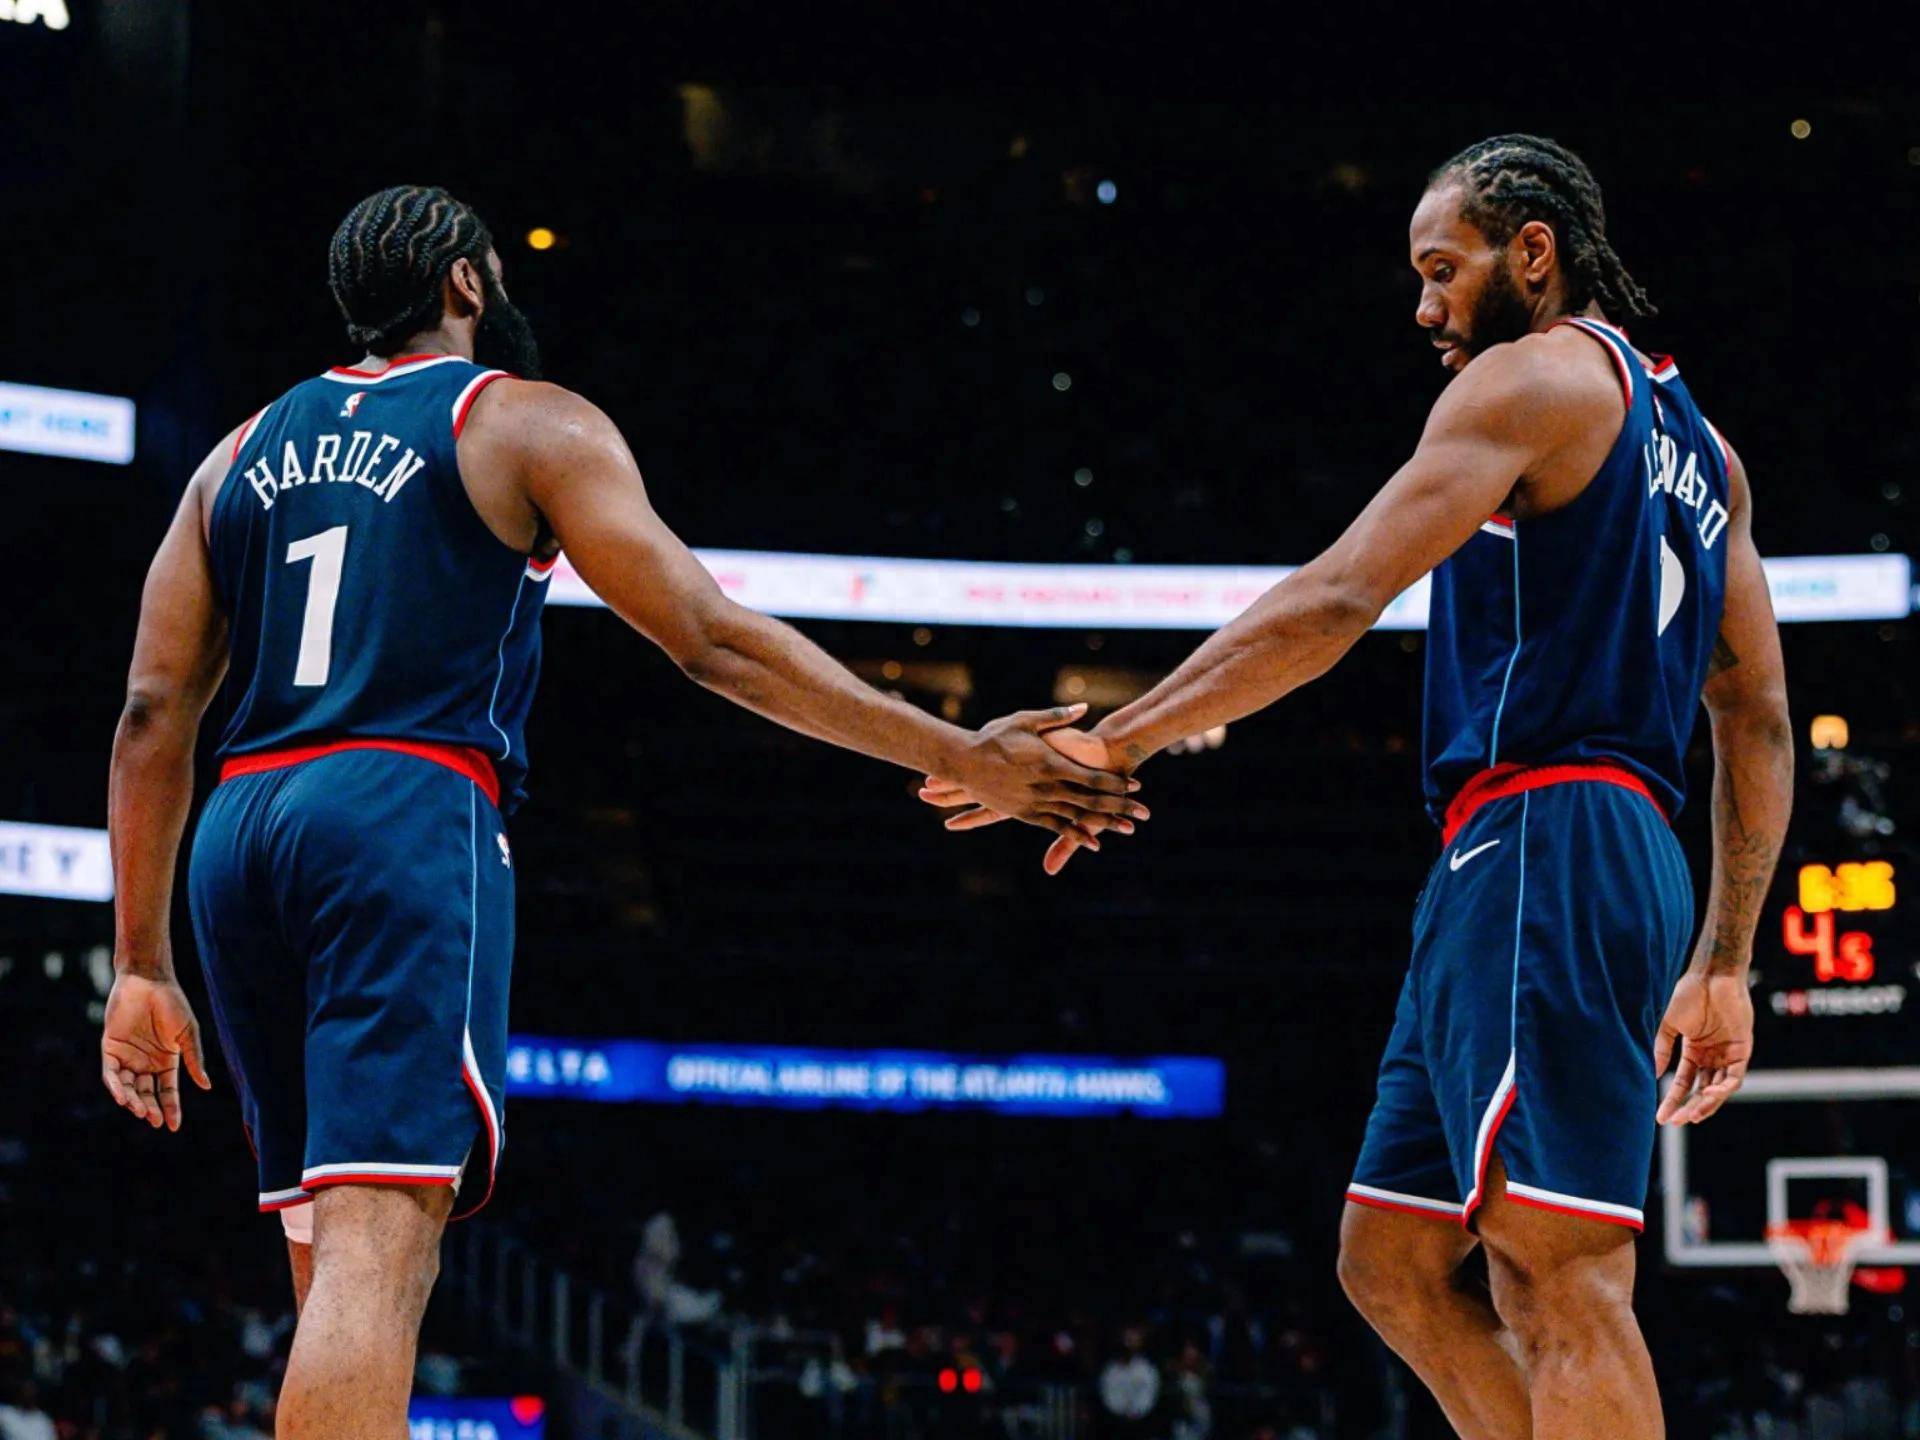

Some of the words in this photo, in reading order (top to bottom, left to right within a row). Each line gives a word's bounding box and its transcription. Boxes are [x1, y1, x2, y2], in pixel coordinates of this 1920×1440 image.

[244, 431, 425, 511] HARDEN
[285, 525, 348, 687] 1
[668, 1056, 772, 1092] OFFICIAL
[777, 1062, 871, 1096] AIRLINE
[875, 1064, 907, 1098] OF
[912, 1065, 957, 1100] THE
[962, 1066, 1066, 1101] ATLANTA
